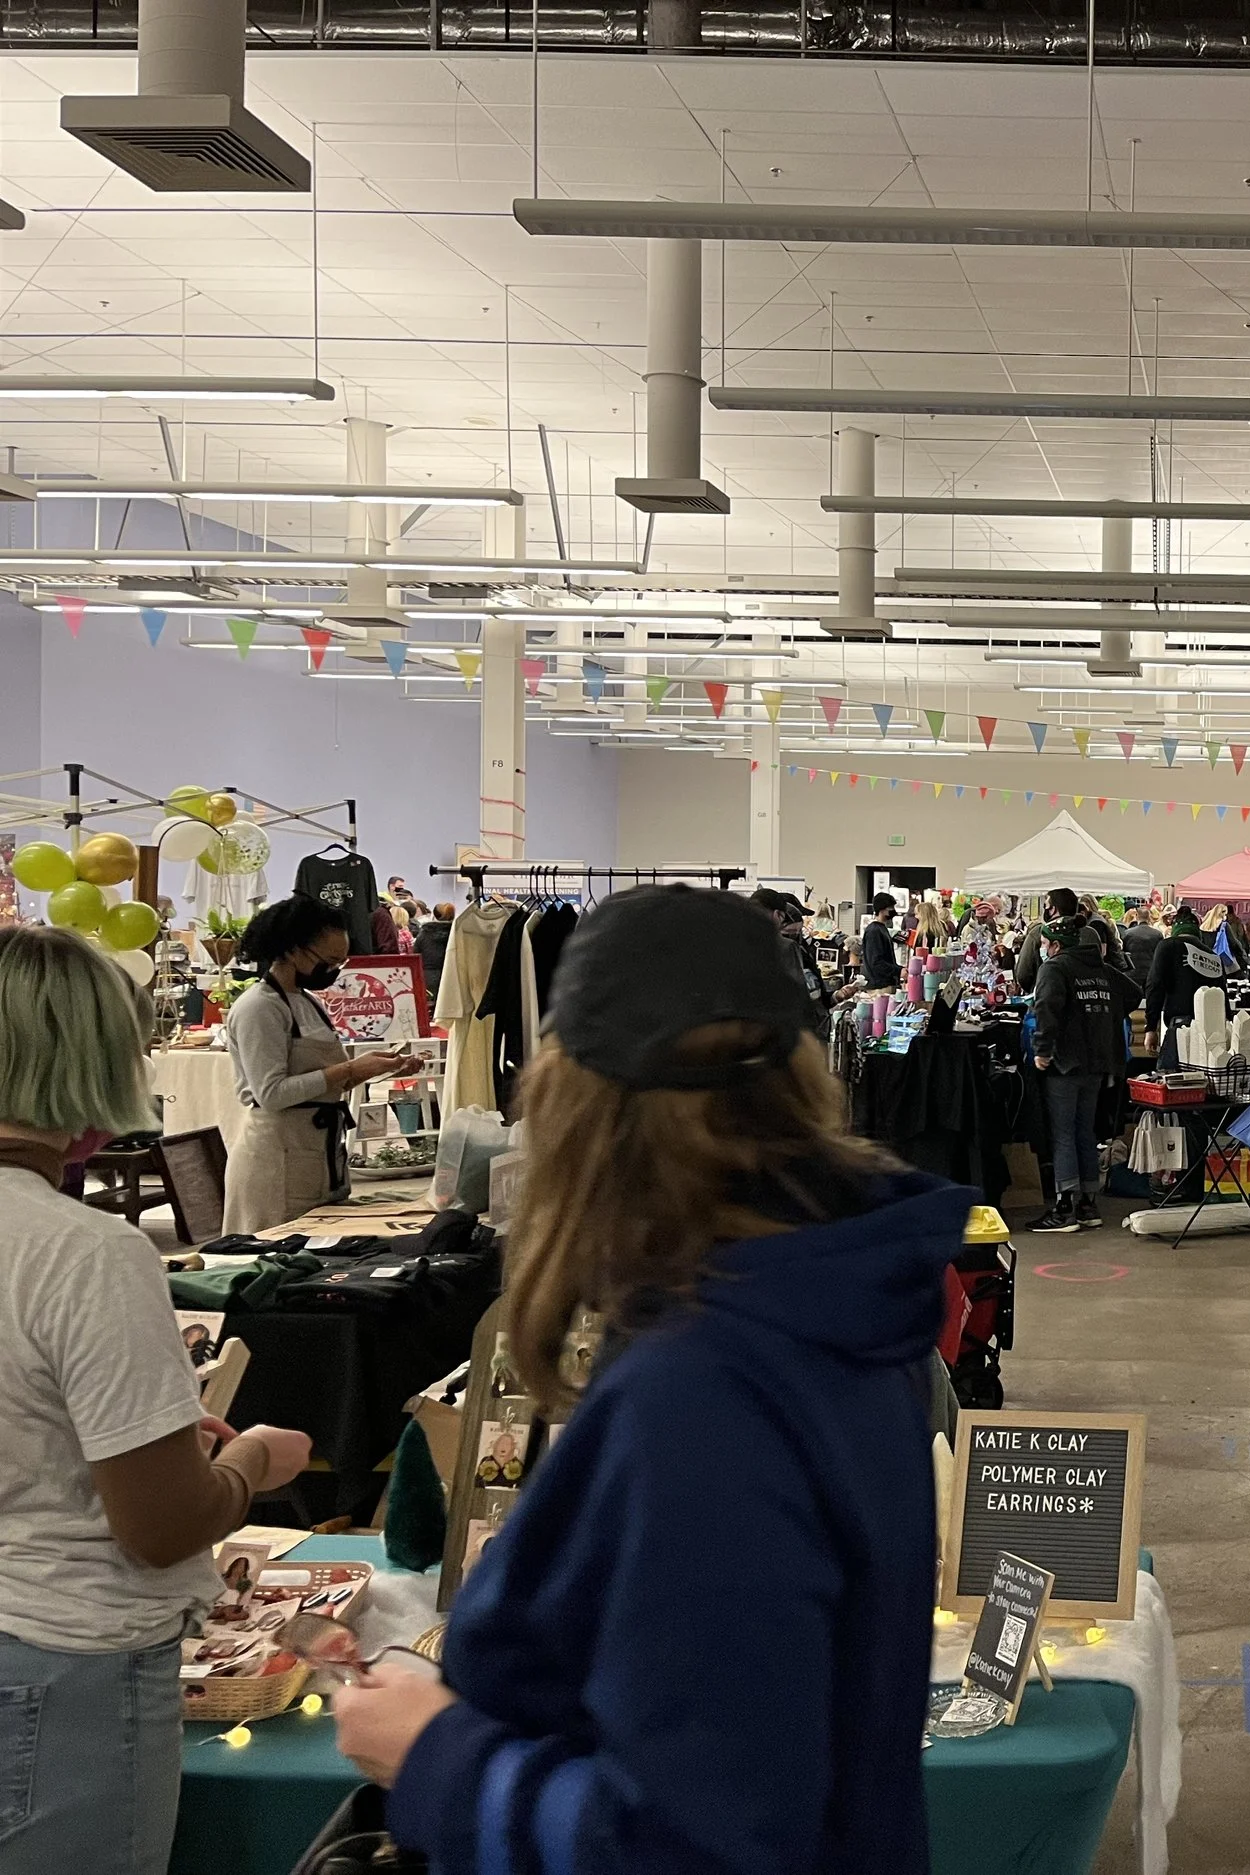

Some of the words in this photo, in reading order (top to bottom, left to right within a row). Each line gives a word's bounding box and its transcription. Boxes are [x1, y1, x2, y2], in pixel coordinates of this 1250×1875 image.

[492, 759, 504, 768] F8
[975, 1431, 1022, 1450] KATIE
[1030, 1433, 1040, 1450] K
[1047, 1433, 1089, 1452] CLAY
[981, 1465, 1057, 1485] POLYMER
[1065, 1468, 1107, 1487] CLAY
